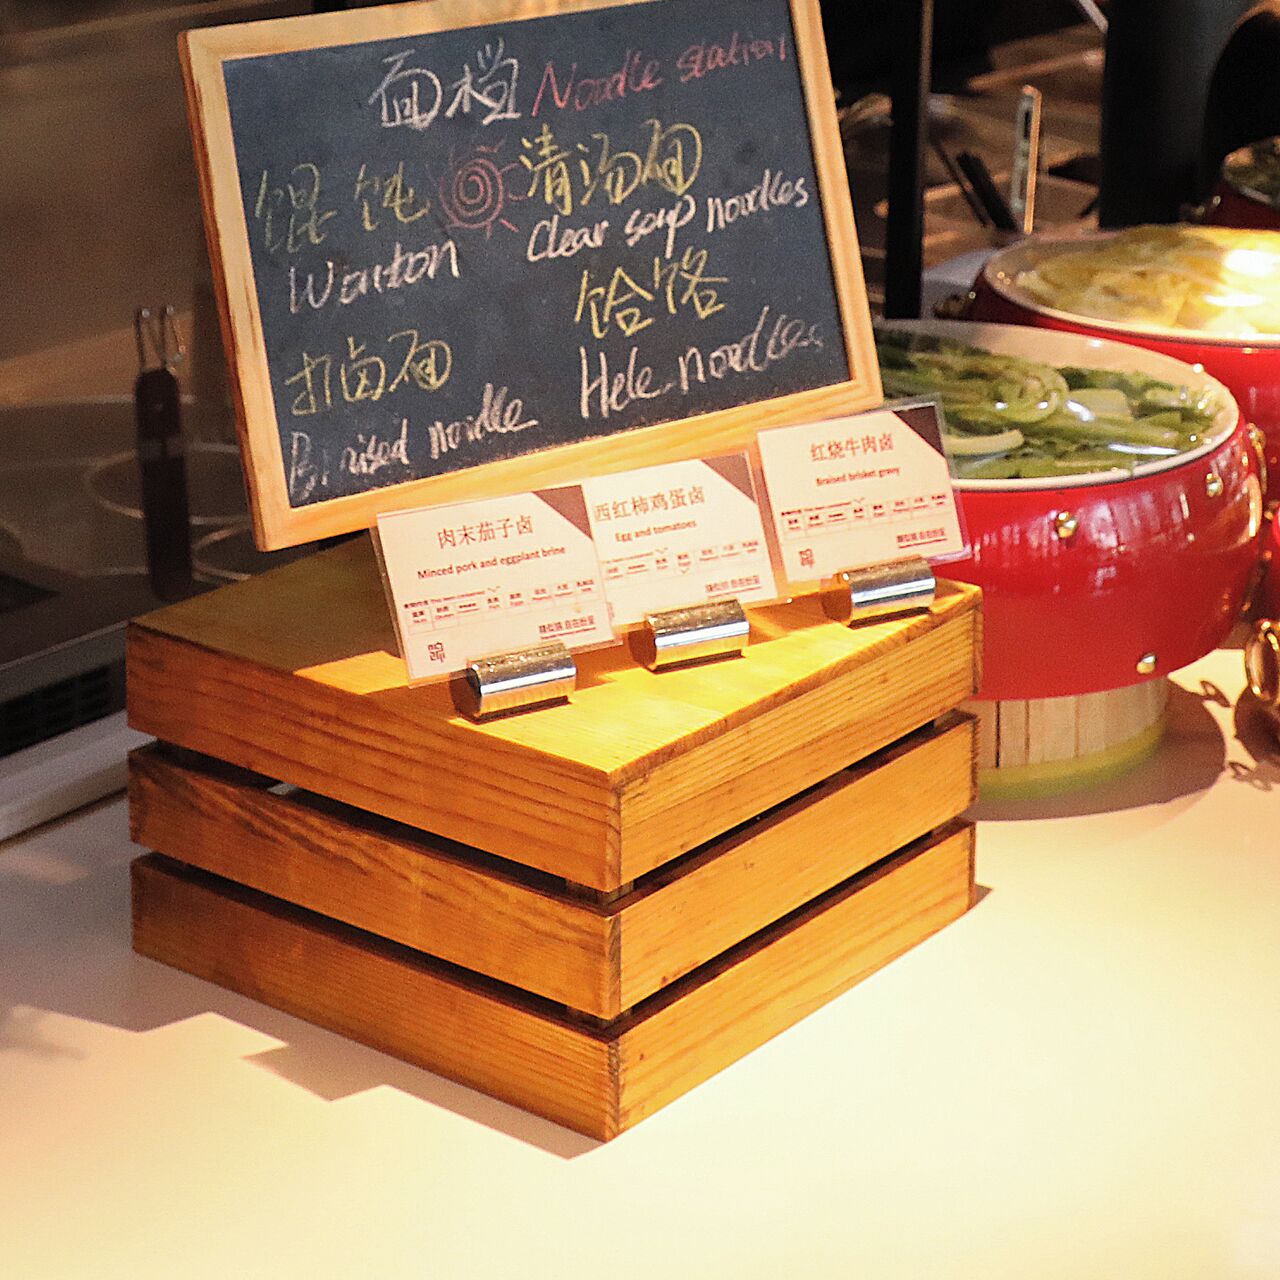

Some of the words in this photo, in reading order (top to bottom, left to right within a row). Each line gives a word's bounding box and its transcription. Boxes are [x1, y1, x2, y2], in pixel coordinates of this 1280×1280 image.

[531, 48, 662, 117] Noodle
[519, 118, 703, 217] 清汤面
[624, 194, 697, 260] soup
[706, 168, 810, 233] noodles
[283, 328, 454, 417] 打卤面
[677, 305, 825, 396] noodles
[810, 432, 895, 462] 红烧牛肉卤
[593, 485, 706, 522] 西红柿鸡蛋卤
[436, 514, 534, 550] 肉末茄子卤
[615, 531, 633, 543] Egg
[634, 524, 652, 539] and
[652, 519, 698, 536] tomatoes
[417, 564, 454, 581] Minced
[455, 561, 478, 576] pork
[479, 556, 499, 569] and
[499, 549, 541, 567] eggplant
[541, 545, 567, 559] brine
